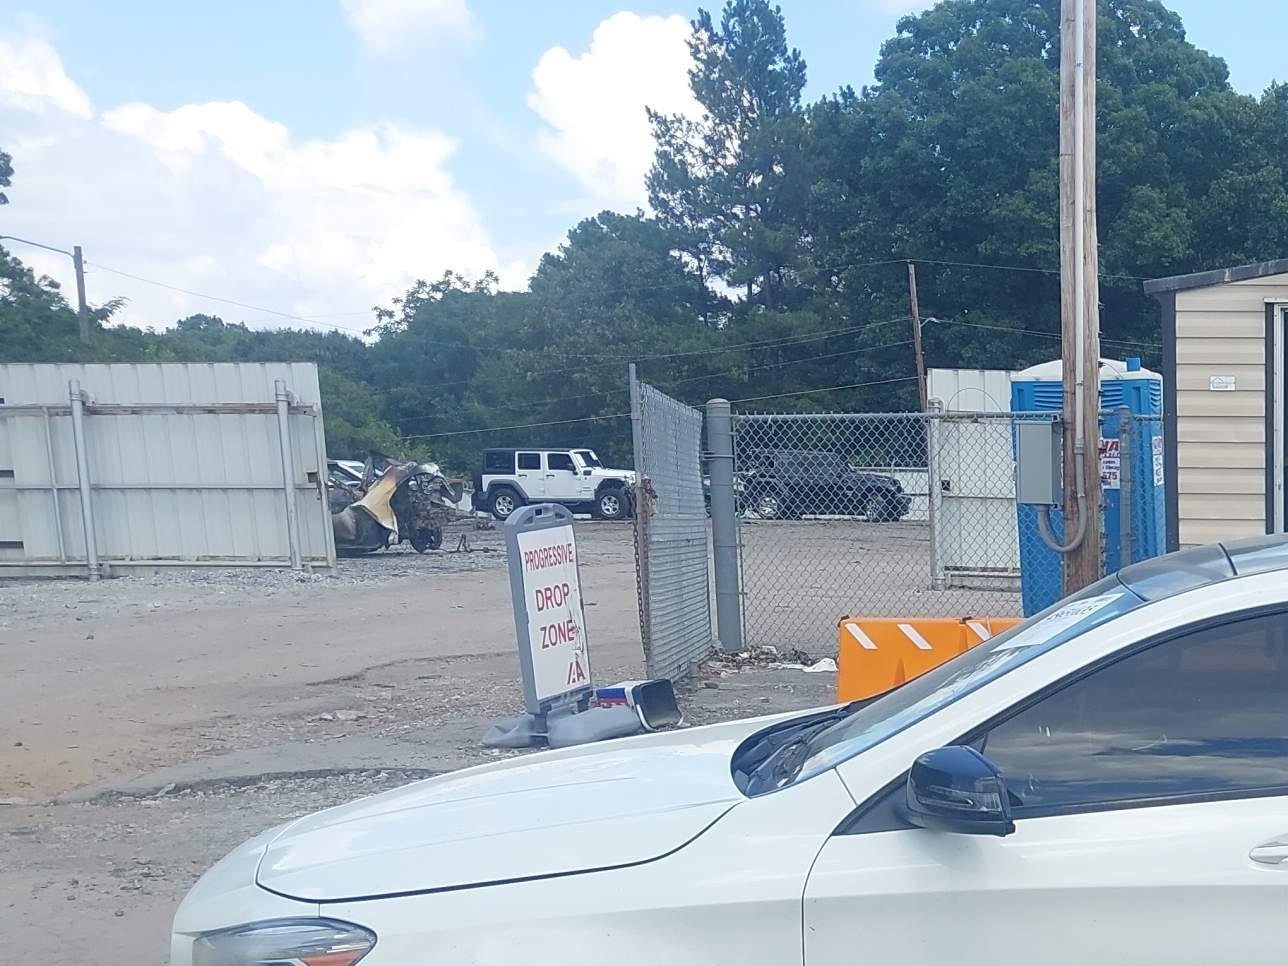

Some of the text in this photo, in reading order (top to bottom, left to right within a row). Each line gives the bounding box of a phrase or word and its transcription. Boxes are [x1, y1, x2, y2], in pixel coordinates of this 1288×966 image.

[524, 543, 574, 572] PROGRESSIVE
[535, 583, 570, 612] DROP
[539, 619, 575, 650] ZONE
